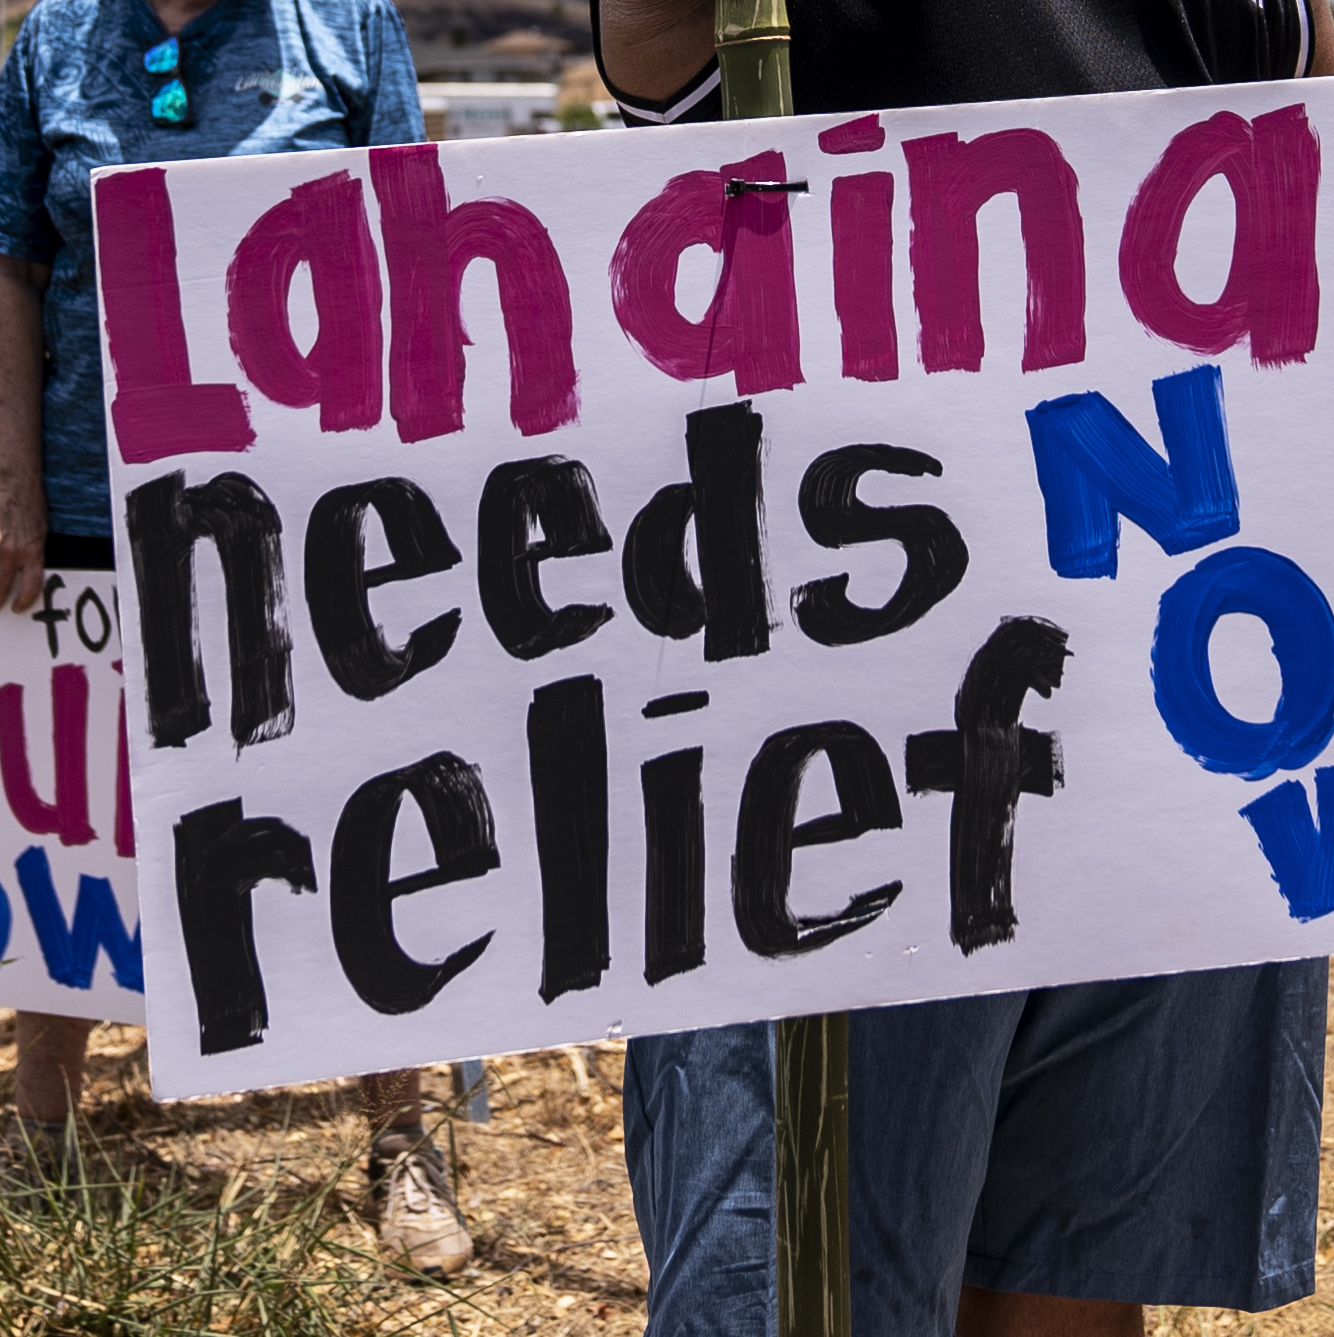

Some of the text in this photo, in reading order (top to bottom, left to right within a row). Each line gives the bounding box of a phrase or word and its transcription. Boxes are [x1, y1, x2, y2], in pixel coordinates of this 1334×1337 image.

[93, 103, 1322, 464] Lahaina
[32, 573, 122, 660] fo
[125, 399, 970, 752] needs
[173, 616, 1073, 1057] relief
